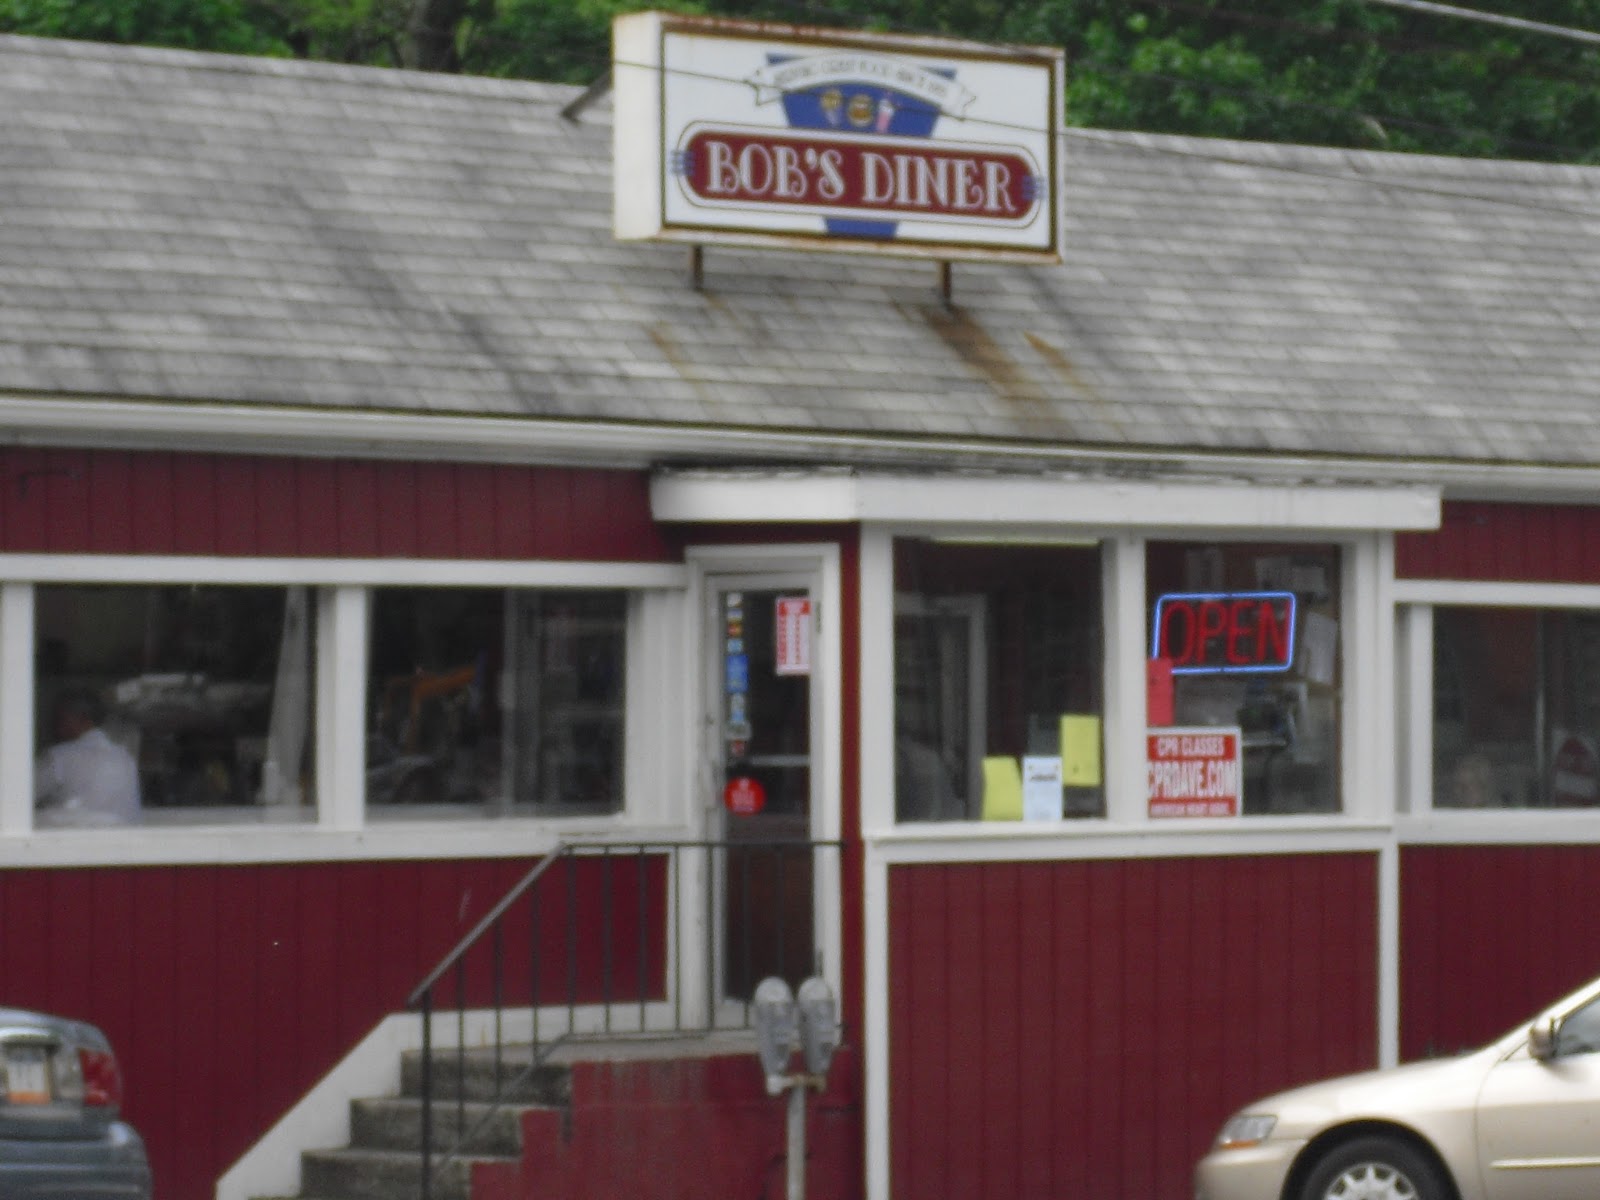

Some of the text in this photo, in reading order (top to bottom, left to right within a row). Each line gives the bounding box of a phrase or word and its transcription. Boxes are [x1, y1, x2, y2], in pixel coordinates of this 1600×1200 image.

[705, 140, 1017, 213] BOB'S DINER
[1160, 600, 1292, 665] OPEN
[1182, 736, 1224, 755] CLASSES
